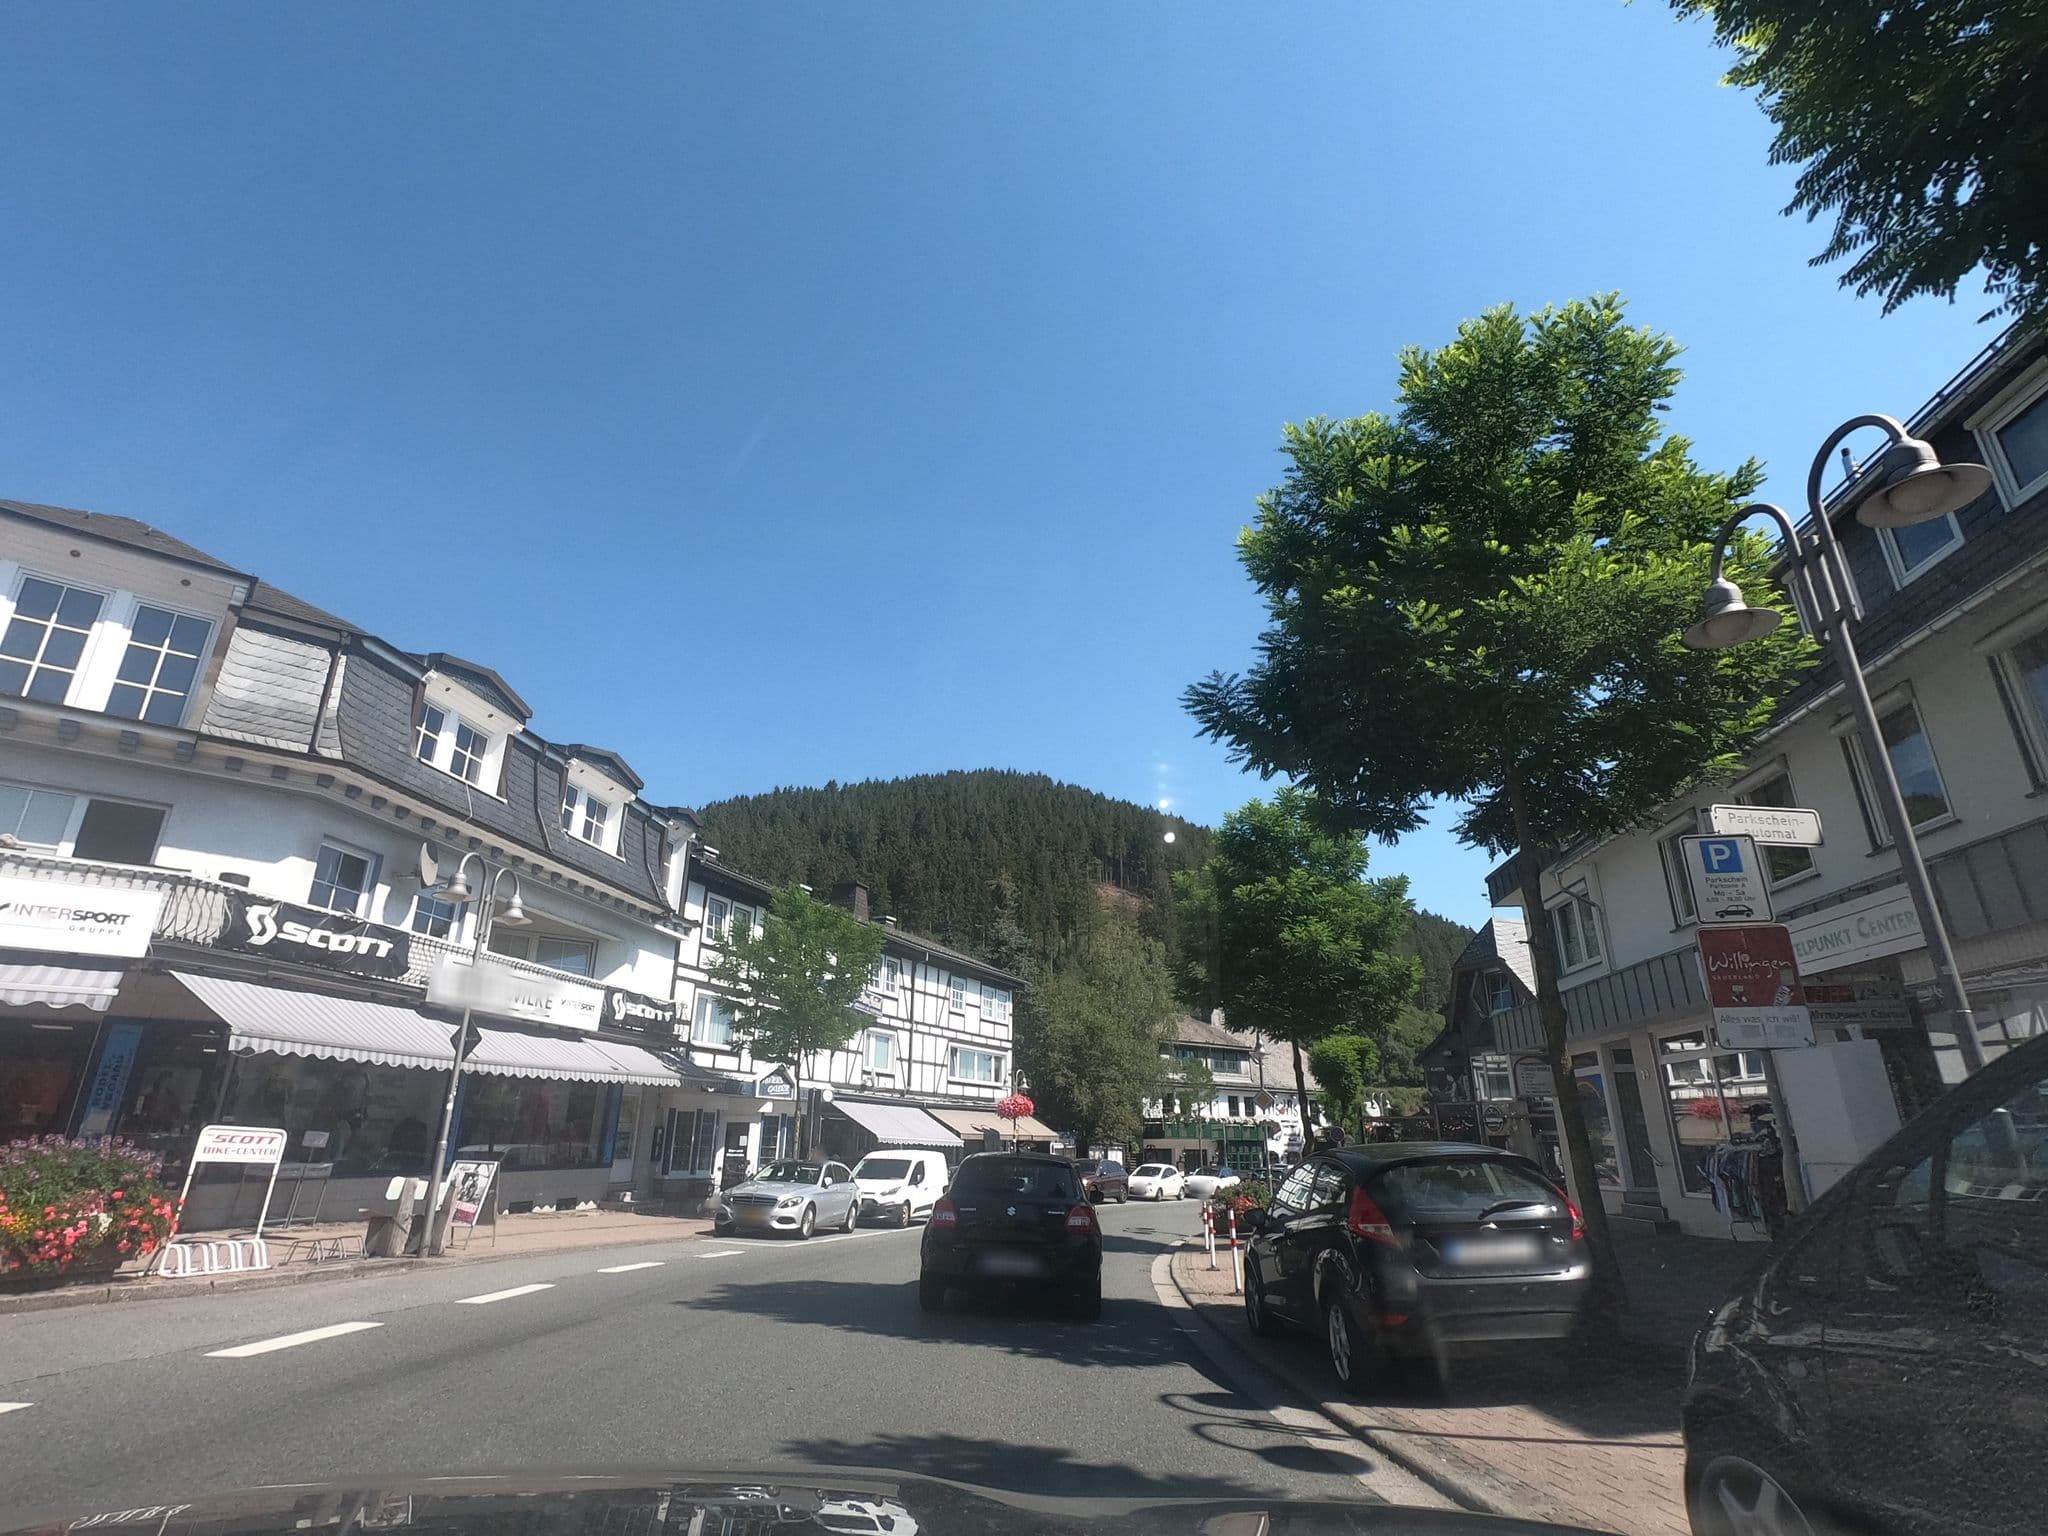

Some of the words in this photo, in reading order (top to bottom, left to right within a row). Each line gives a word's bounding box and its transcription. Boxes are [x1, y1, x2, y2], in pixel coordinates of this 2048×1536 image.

[1727, 812, 1805, 826] Parkschein-
[1708, 844, 1731, 870] P
[14, 903, 131, 925] INTERSPORT
[276, 921, 394, 958] SCOTT
[1795, 928, 1851, 957] ELPUNKT
[1856, 910, 1917, 938] CENTER
[1709, 951, 1792, 978] Willingen
[626, 1002, 674, 1022] SCOTT
[212, 1134, 278, 1145] SCOTT
[203, 1146, 276, 1156] BIKE-CENTER
